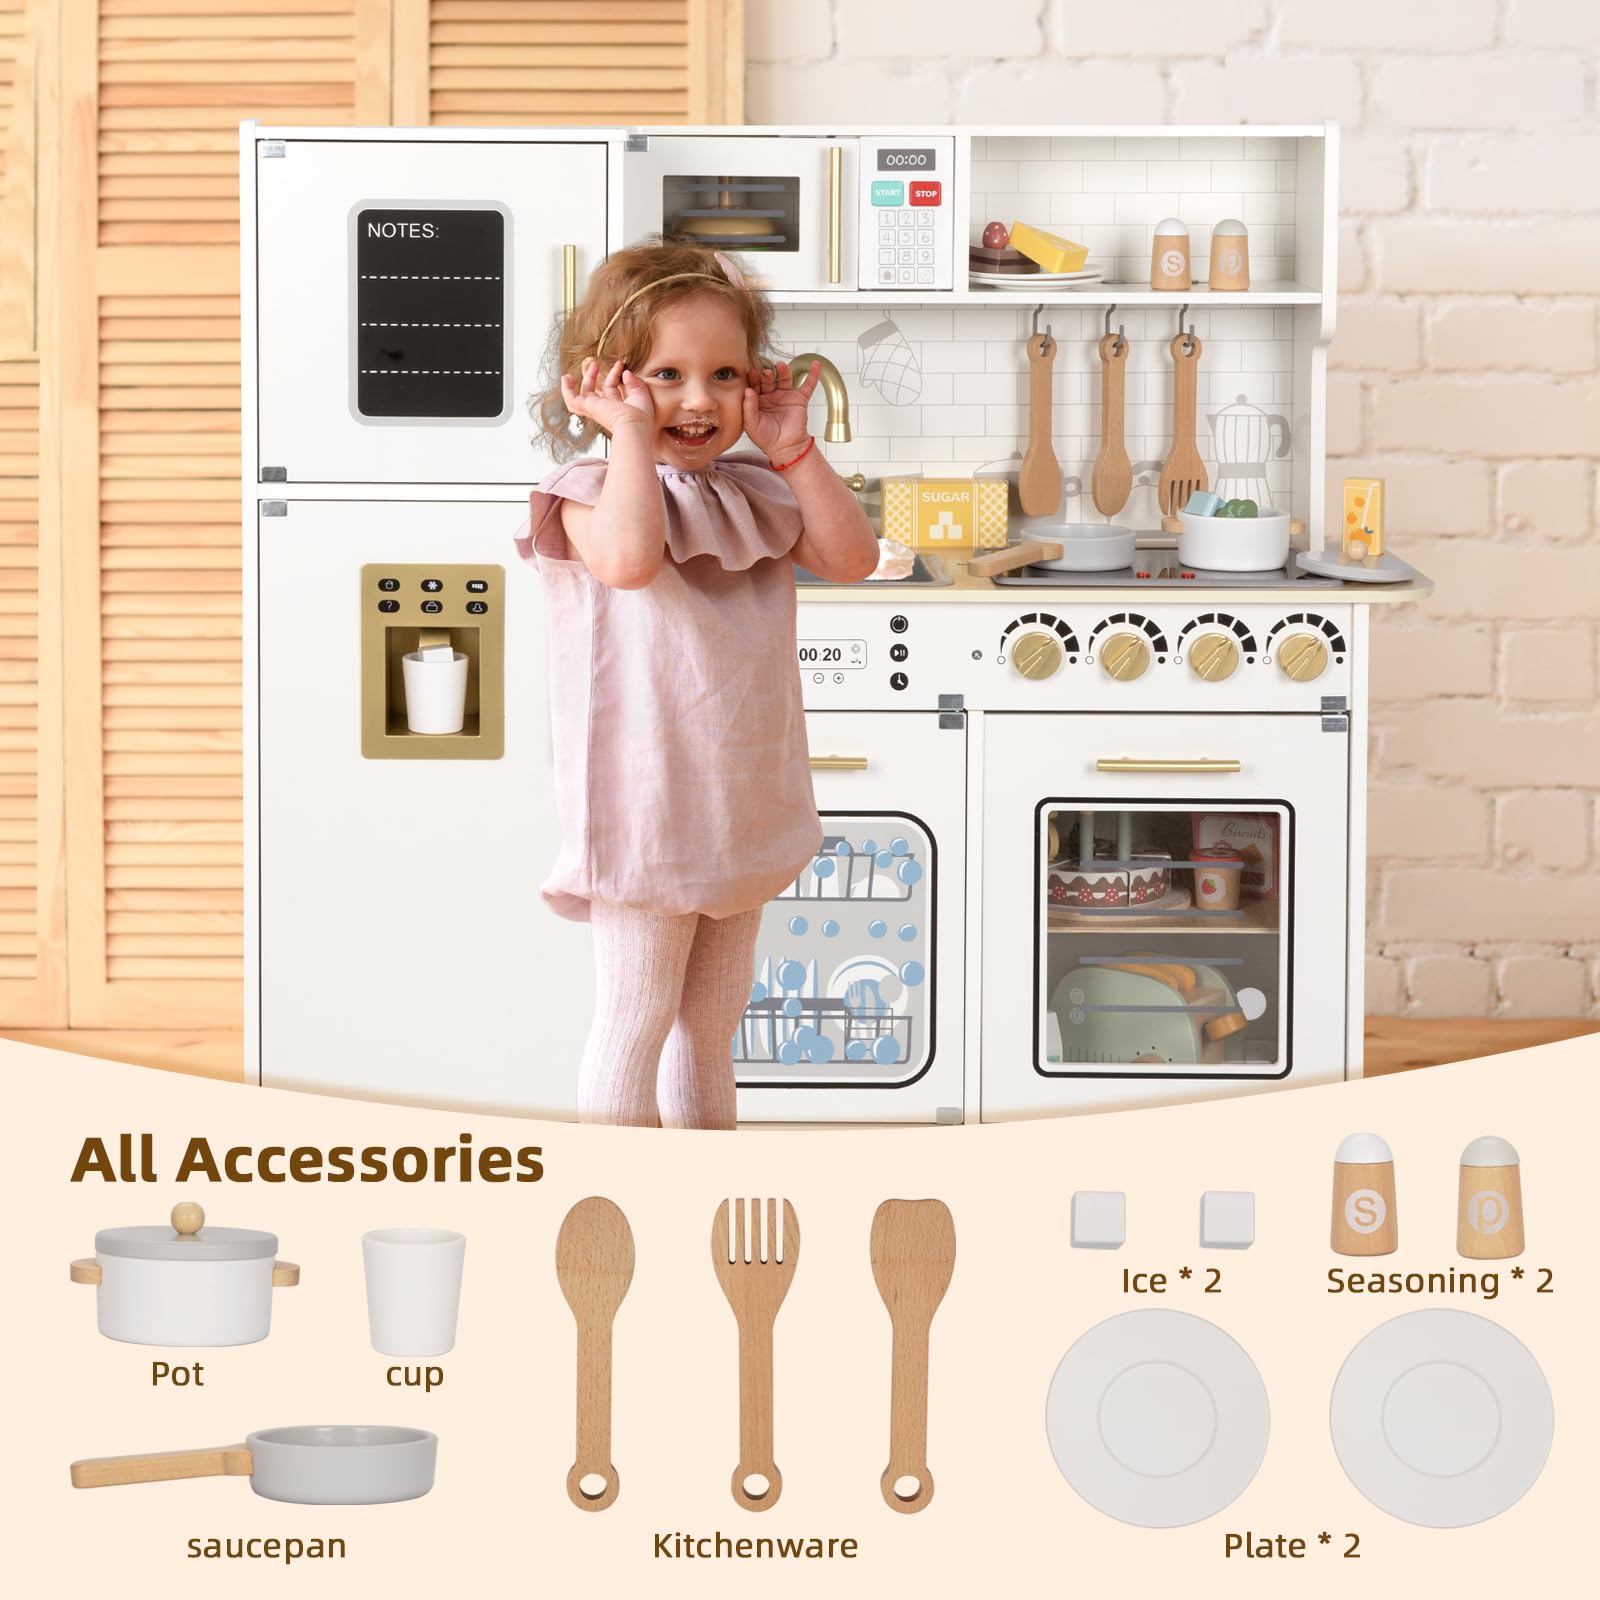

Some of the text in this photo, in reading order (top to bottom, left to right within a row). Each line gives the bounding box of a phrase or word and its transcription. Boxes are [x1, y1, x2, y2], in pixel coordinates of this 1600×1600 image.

[886, 154, 927, 166] 00:00
[875, 189, 901, 197] START
[915, 190, 938, 198] STOP
[884, 213, 930, 225] 1 2 3
[367, 222, 440, 239] NOTES:
[883, 232, 930, 243] 4 5 6
[883, 251, 930, 263] 7 8 9
[921, 491, 970, 503] SUGAR
[799, 648, 842, 662] 00:20
[1222, 822, 1267, 840] Biscuits
